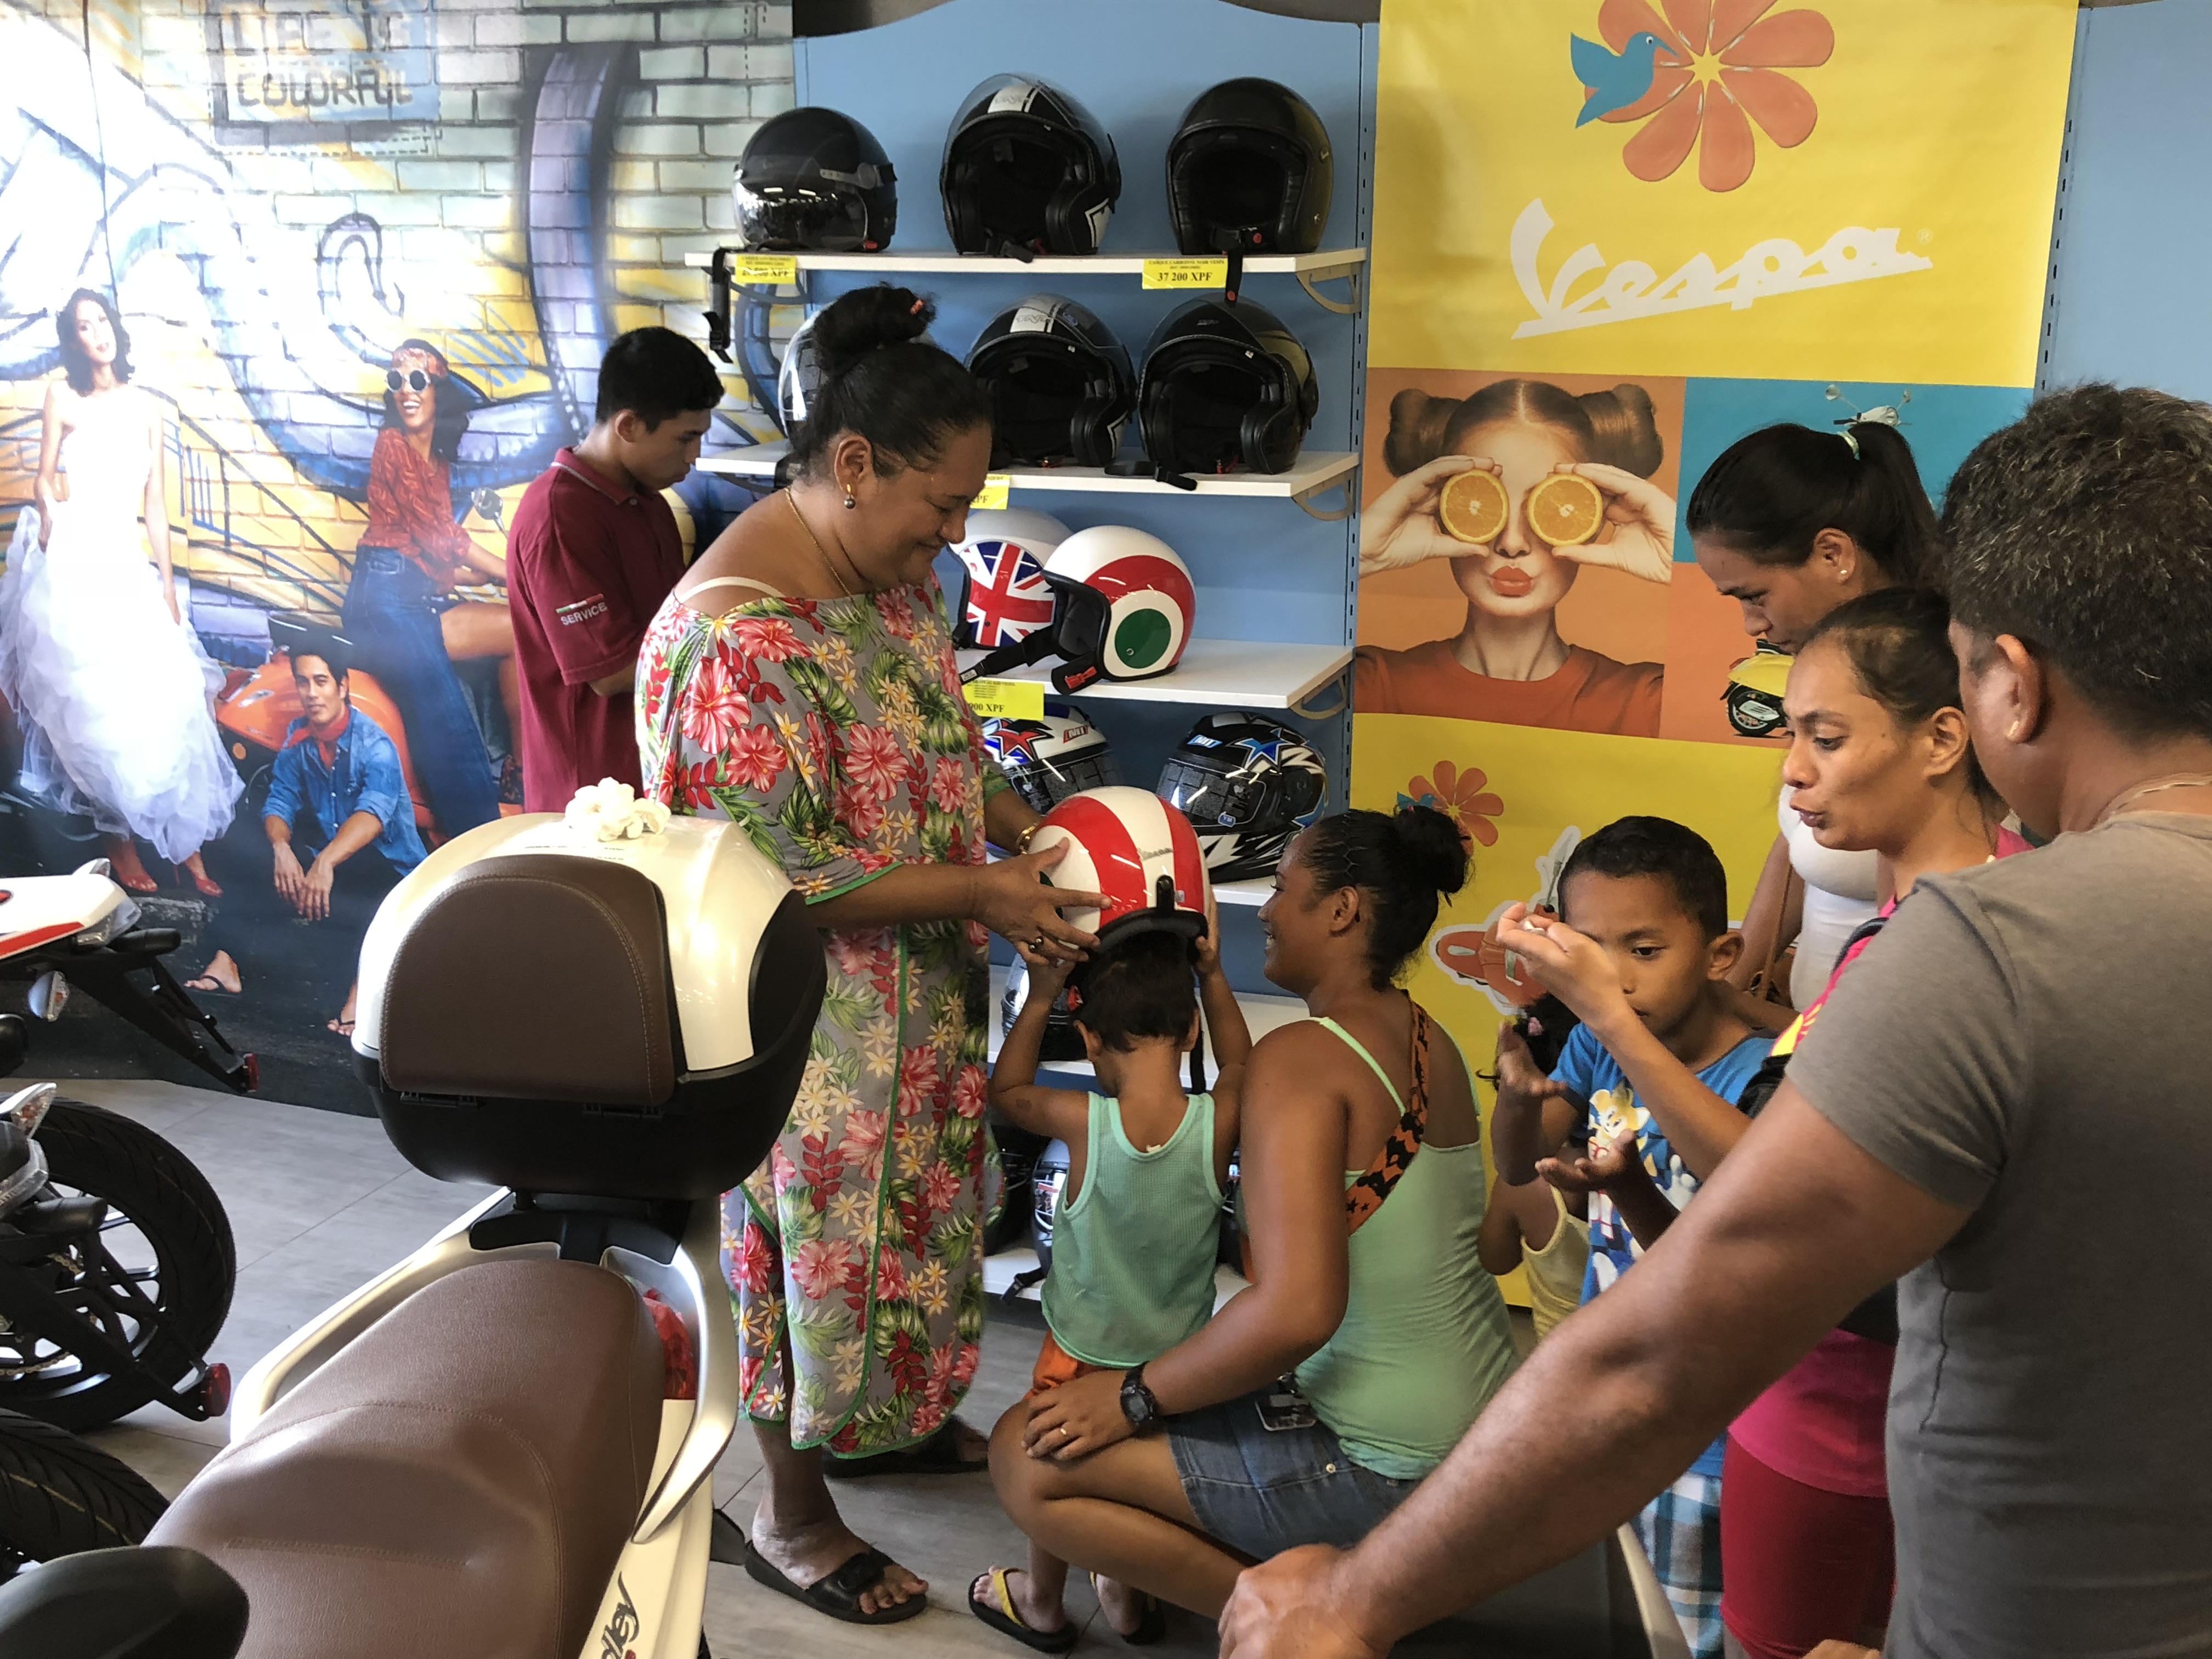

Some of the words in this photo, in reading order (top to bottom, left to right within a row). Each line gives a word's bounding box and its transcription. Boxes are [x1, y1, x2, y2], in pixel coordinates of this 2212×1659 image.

[1158, 272, 1169, 281] 37
[1171, 272, 1188, 281] 200
[1191, 272, 1212, 281] XPF
[1510, 198, 1933, 339] Vespa
[560, 602, 608, 626] SERVICE
[986, 704, 1005, 713] XPF
